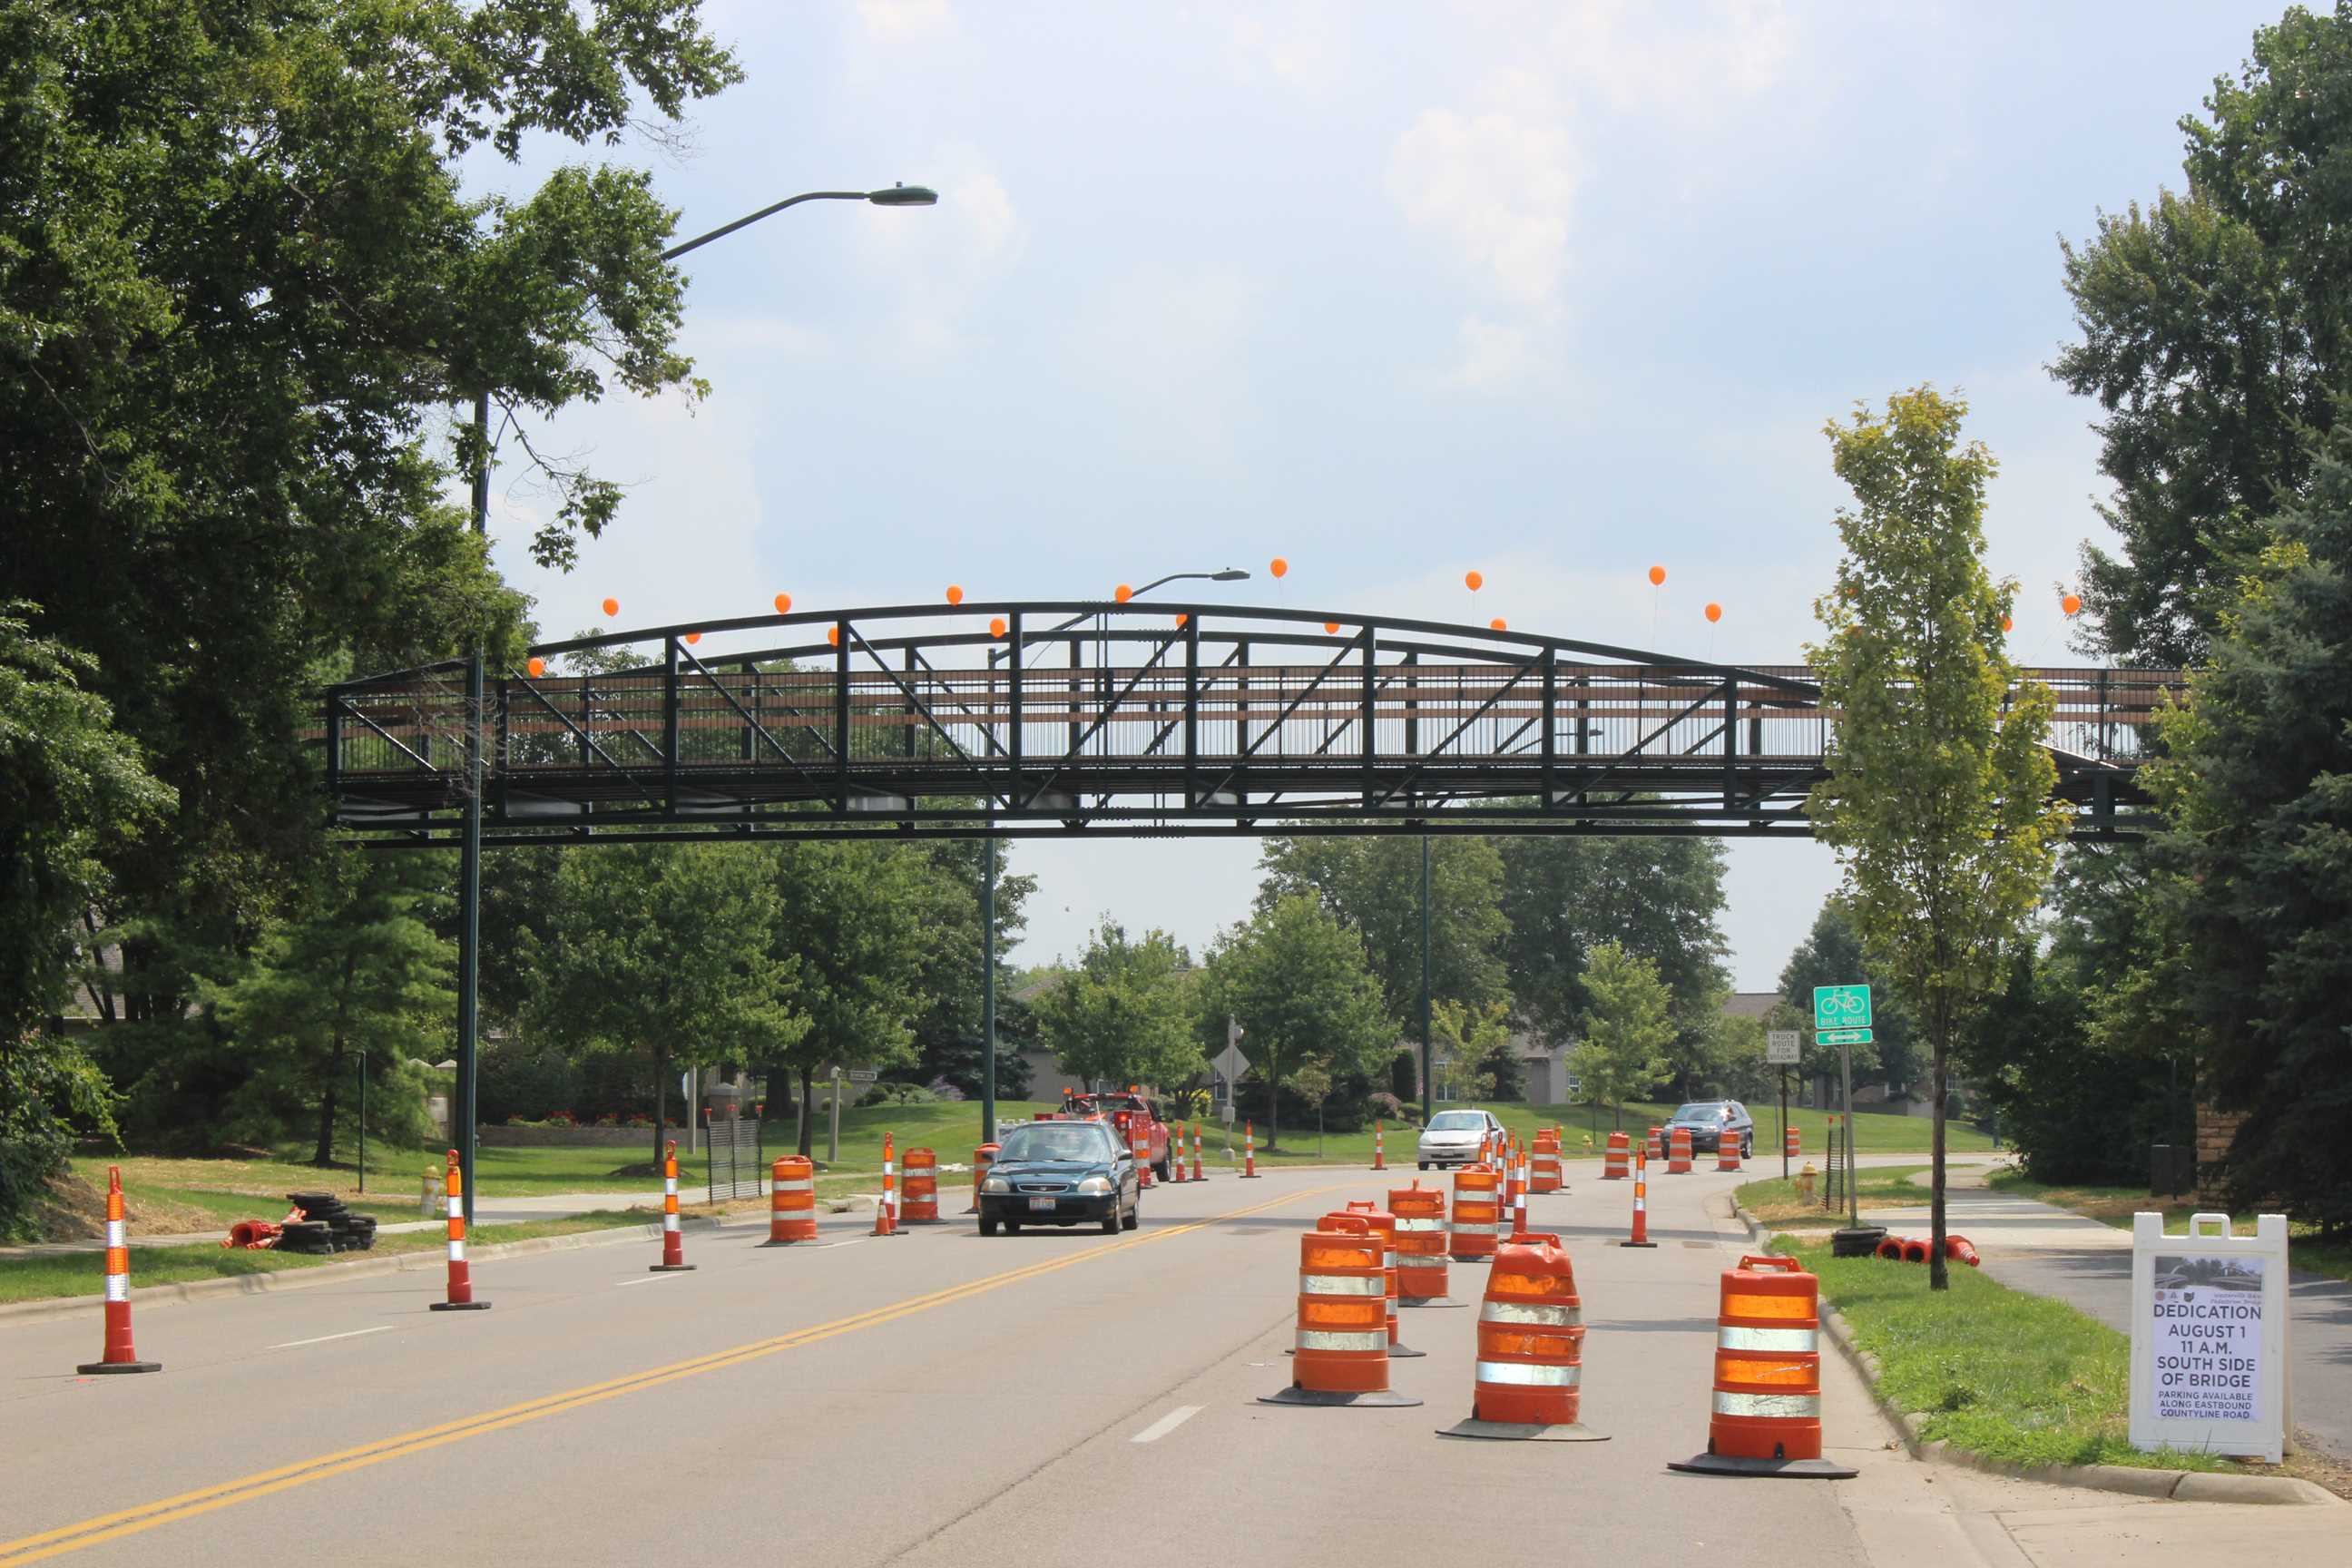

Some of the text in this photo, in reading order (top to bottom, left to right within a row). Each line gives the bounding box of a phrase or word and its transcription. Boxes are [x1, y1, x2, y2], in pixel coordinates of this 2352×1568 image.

[2153, 1304, 2261, 1319] DEDICATION
[2169, 1324, 2245, 1338] AUGUST 1
[2180, 1341, 2232, 1354] 11 A.M.
[2158, 1357, 2255, 1371] SOUTH SIDE
[2161, 1373, 2250, 1387] OF BRIDGE
[2159, 1391, 2252, 1400] PARKING AVAILABLE
[2161, 1400, 2251, 1410] ALONG EASTBOUND
[2161, 1409, 2250, 1419] COUNTYLINE ROAD
